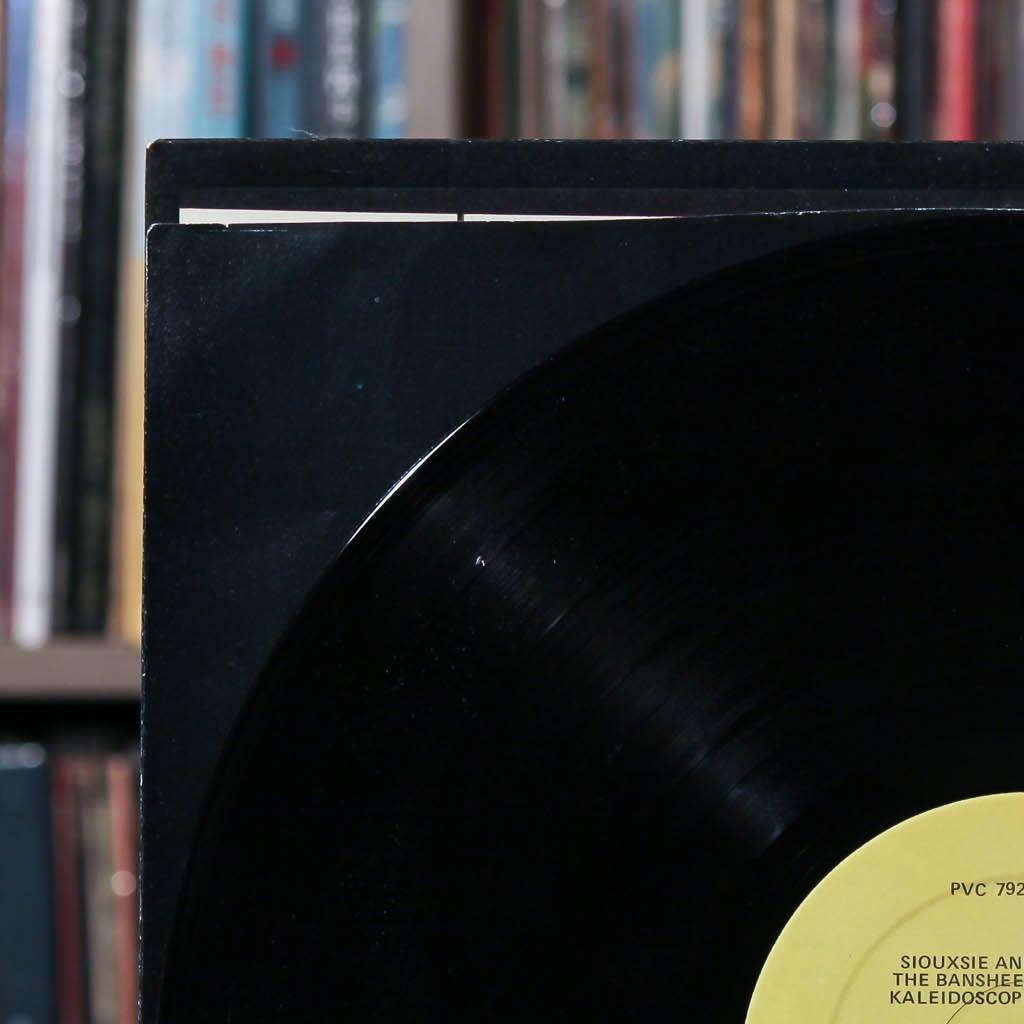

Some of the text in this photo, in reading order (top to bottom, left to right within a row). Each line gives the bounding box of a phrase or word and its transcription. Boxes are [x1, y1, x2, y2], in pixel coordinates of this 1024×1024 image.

[950, 882, 987, 897] PVC
[900, 955, 988, 970] SIOUXSIE
[893, 973, 929, 987] THE
